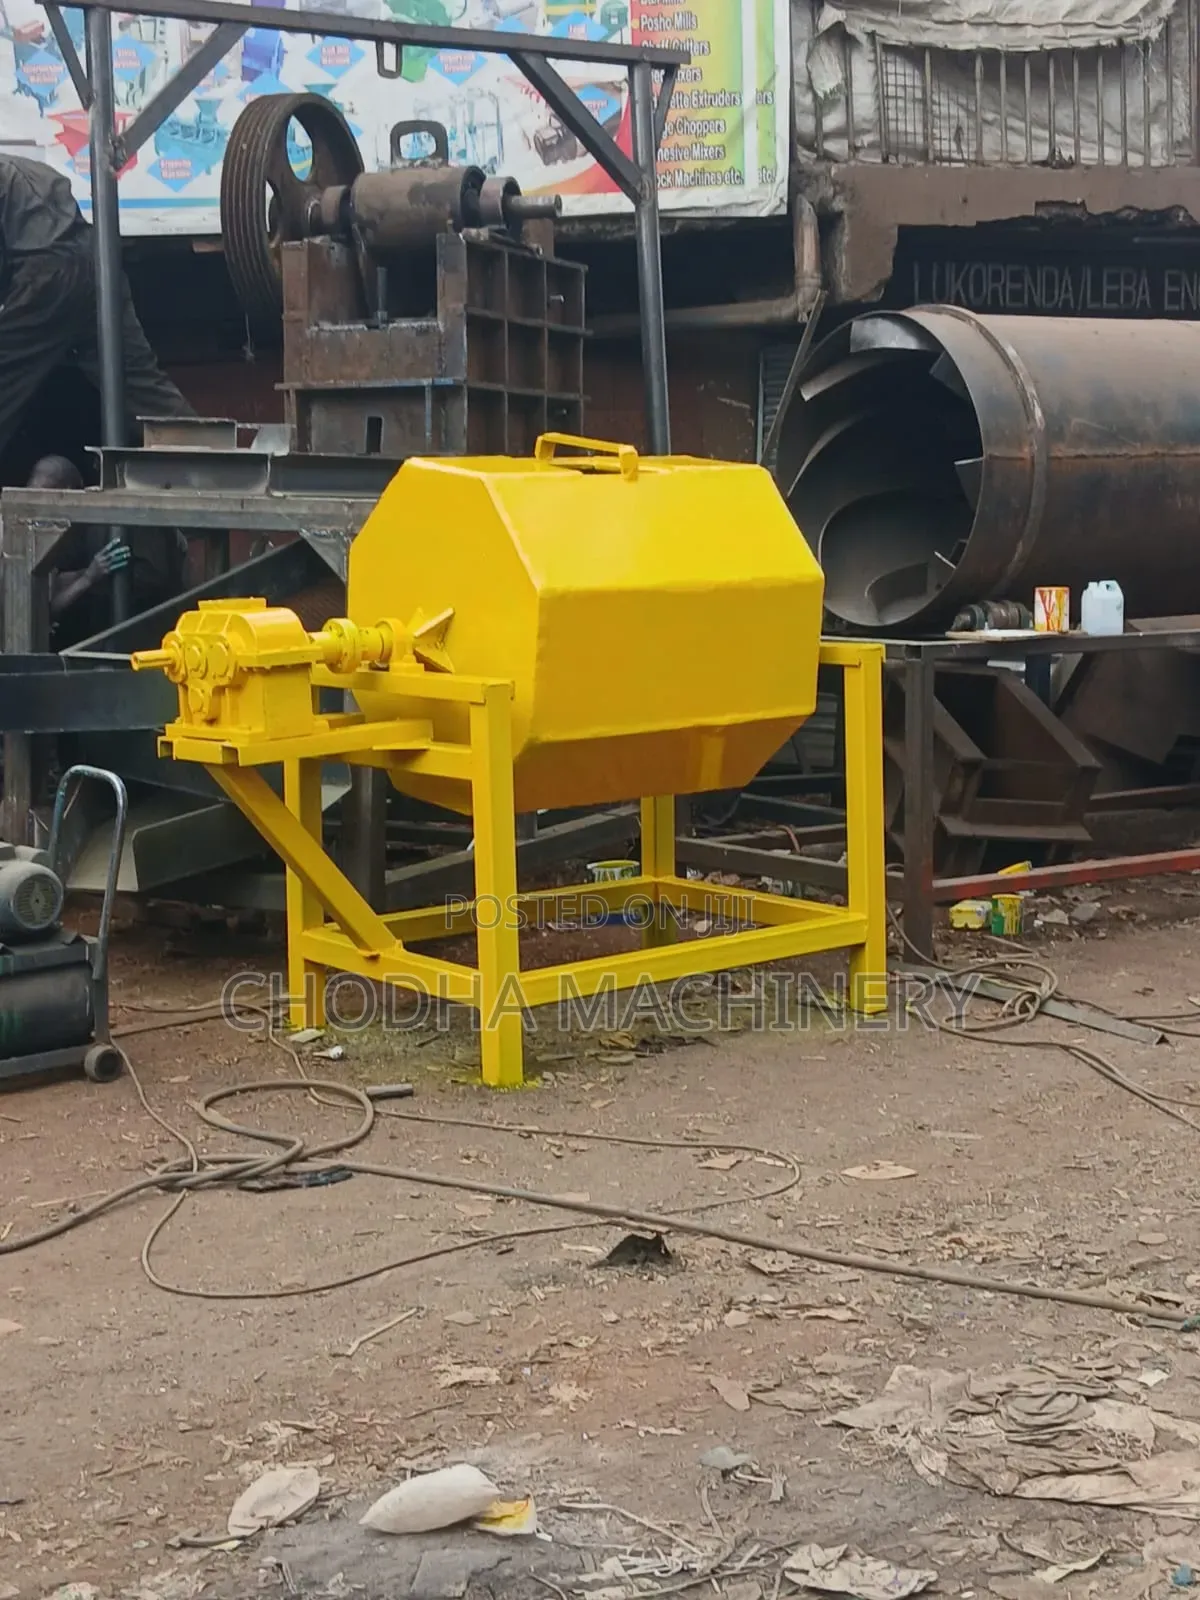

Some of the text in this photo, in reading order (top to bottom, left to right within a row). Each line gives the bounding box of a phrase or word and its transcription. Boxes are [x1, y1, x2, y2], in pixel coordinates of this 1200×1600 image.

[640, 11, 697, 32] Posho Mills
[691, 89, 741, 109] Extruders
[676, 117, 725, 137] Choppers
[691, 141, 725, 160] Mixers
[674, 168, 722, 188] Machines
[1163, 268, 1200, 312] EN
